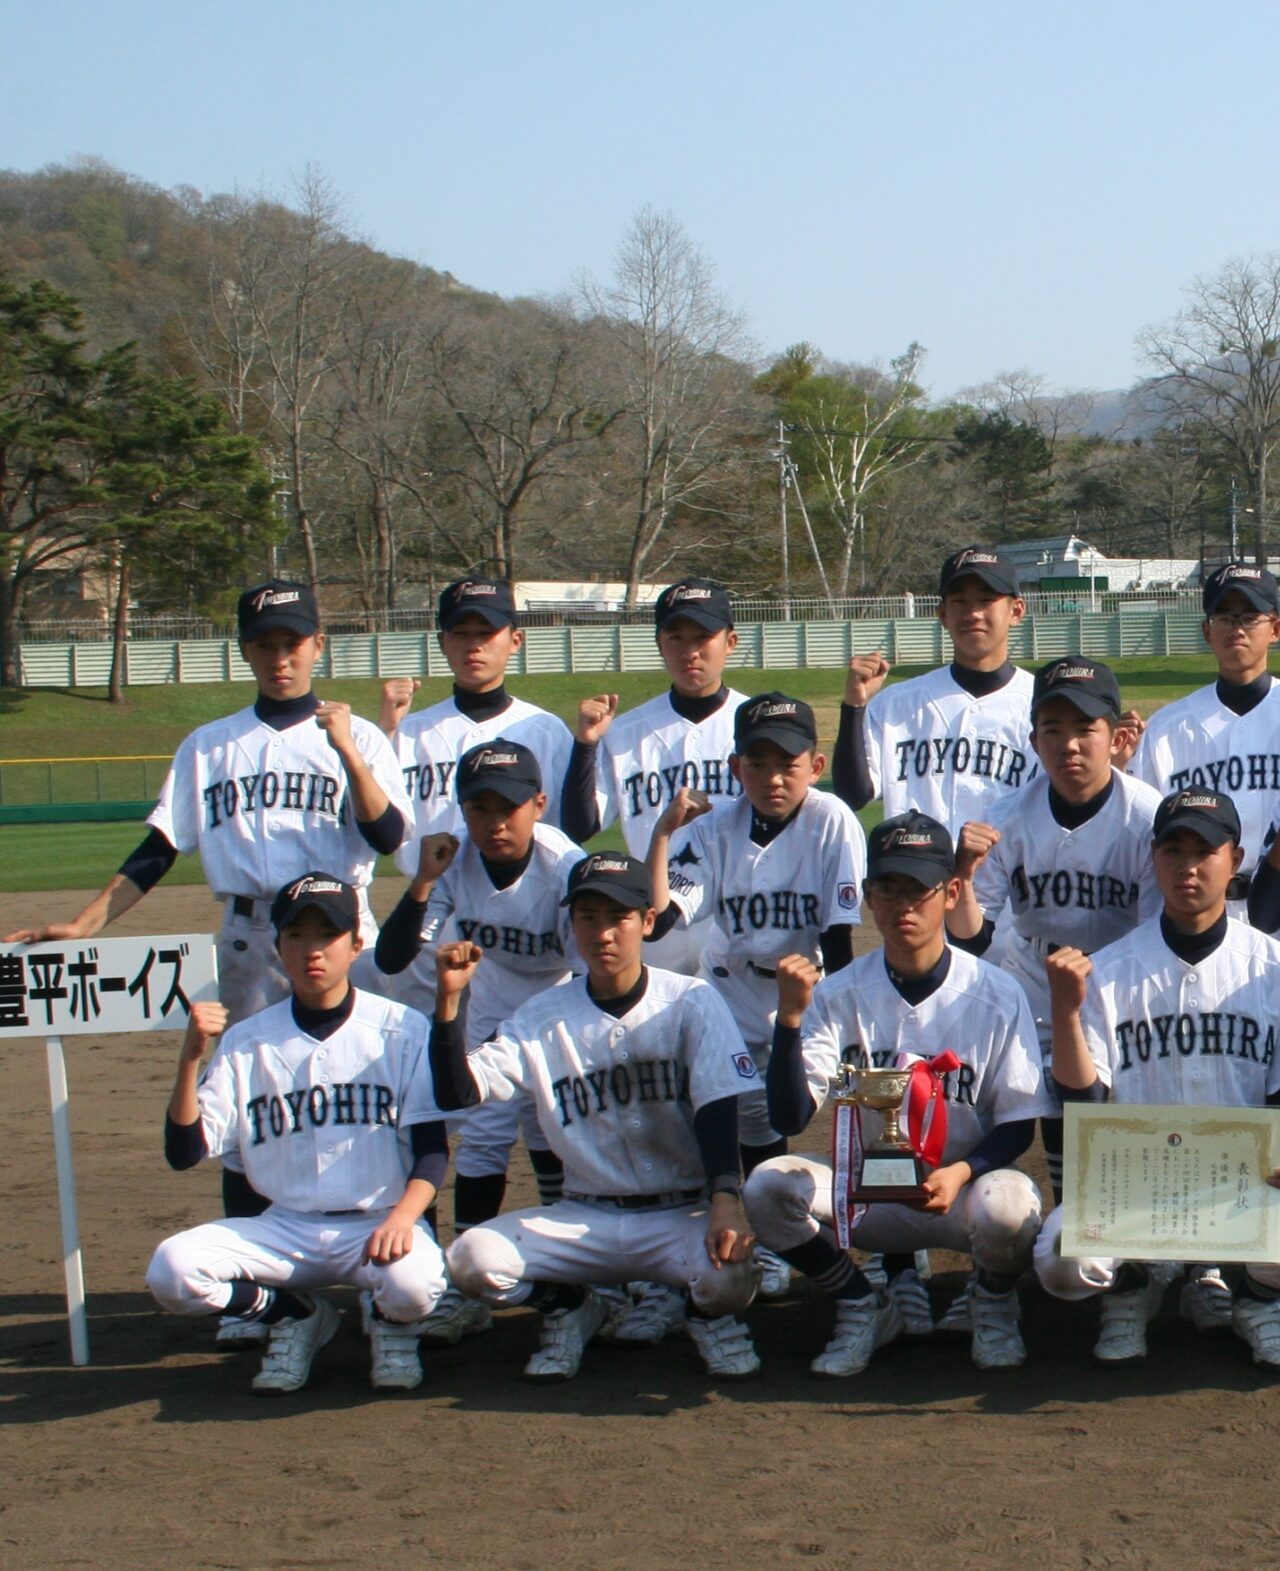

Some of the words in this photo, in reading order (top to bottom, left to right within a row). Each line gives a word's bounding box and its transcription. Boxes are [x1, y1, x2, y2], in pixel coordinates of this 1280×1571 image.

[0, 943, 192, 1028] 豊平ボーイズ
[1116, 1012, 1275, 1071] TOYOHIRA
